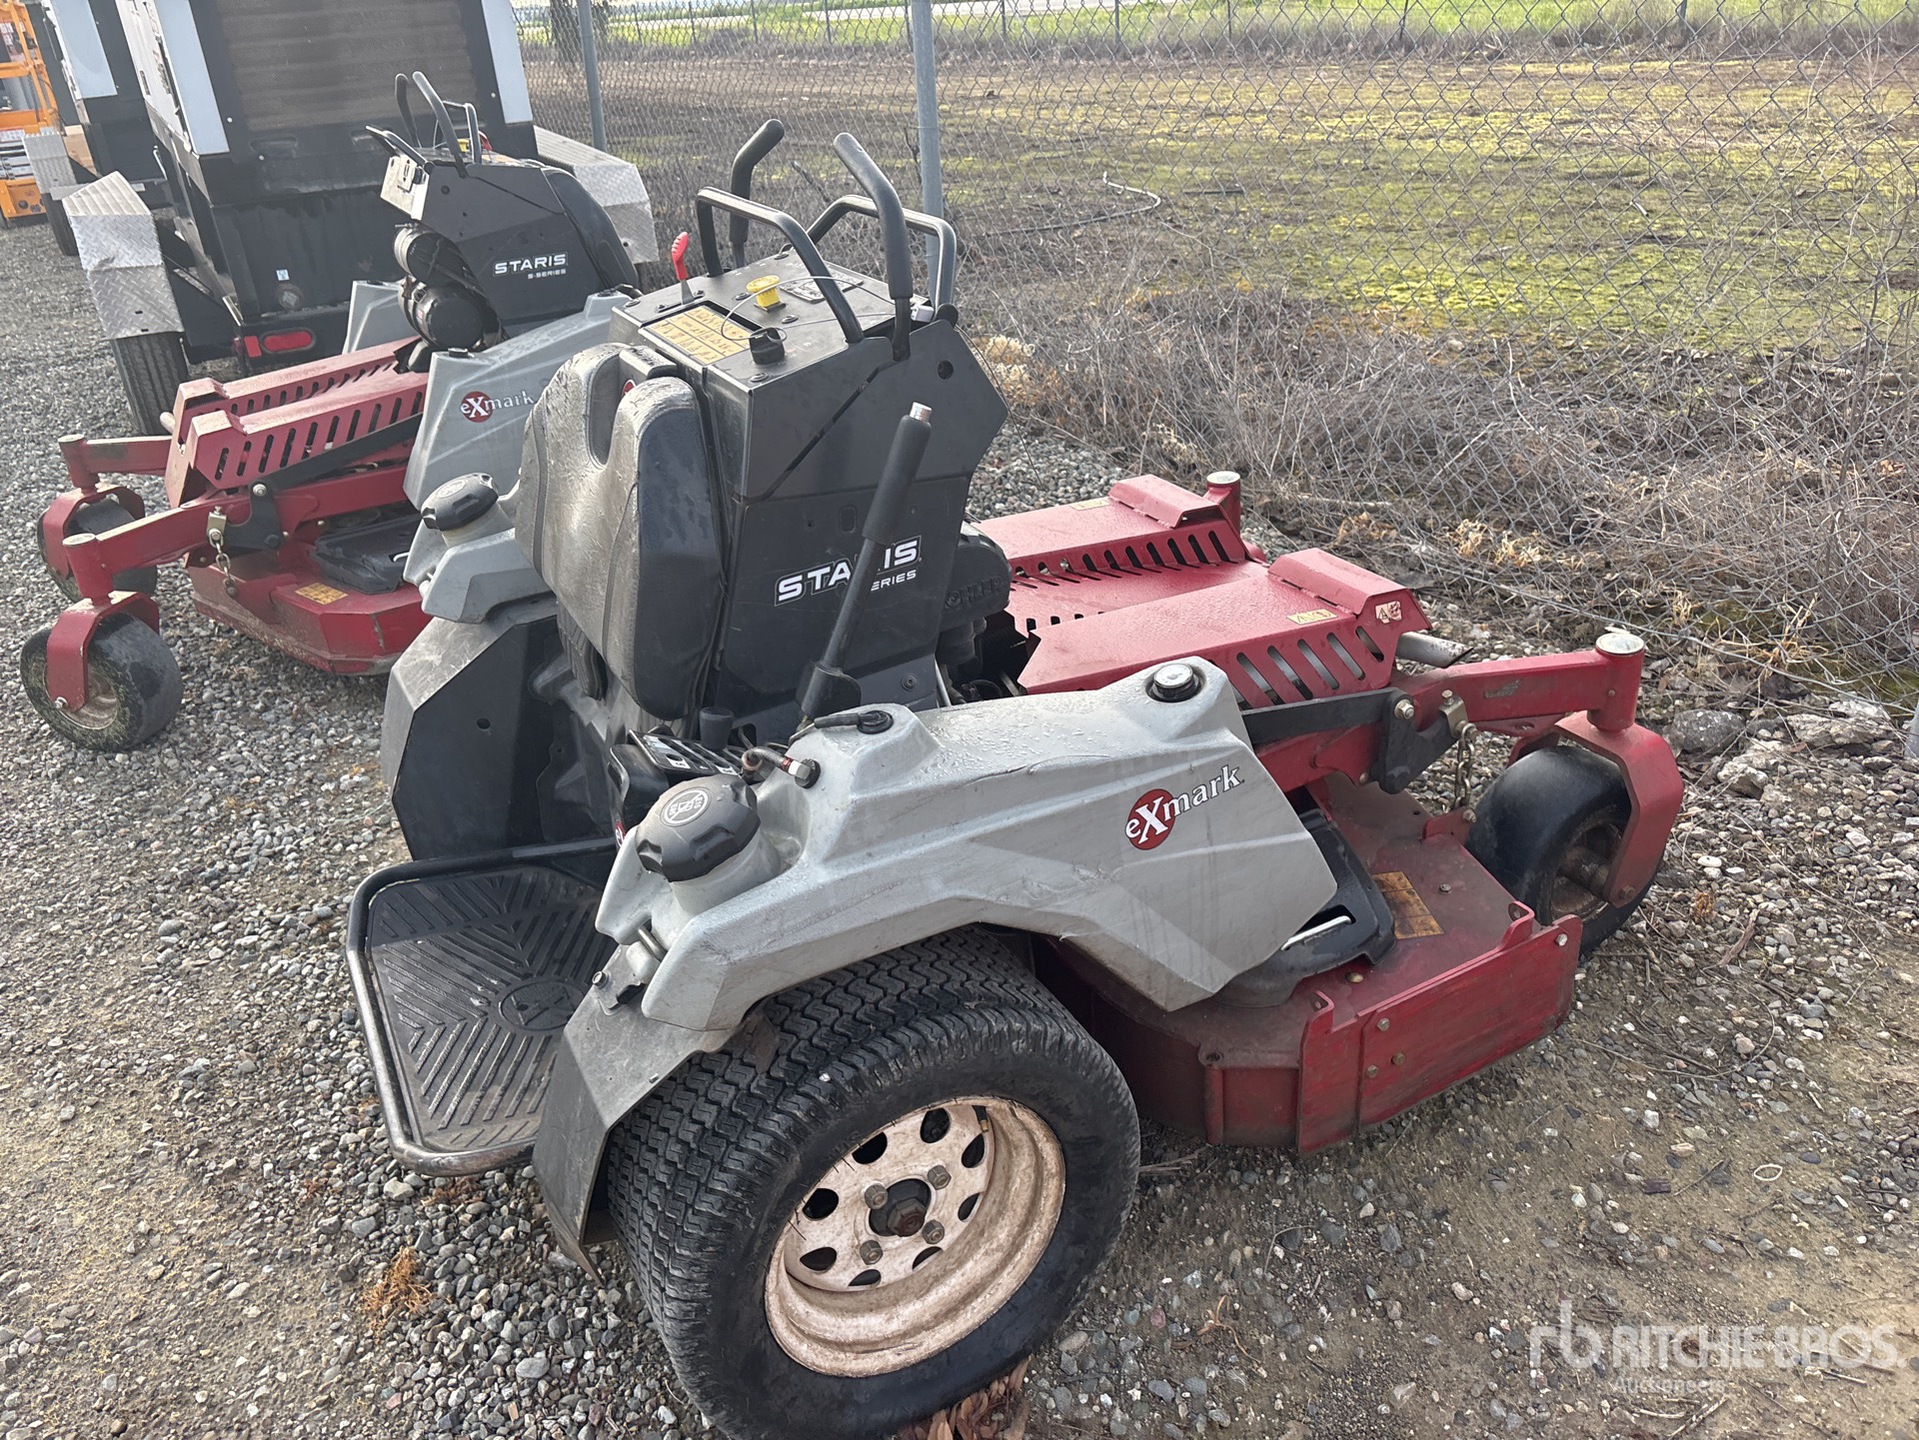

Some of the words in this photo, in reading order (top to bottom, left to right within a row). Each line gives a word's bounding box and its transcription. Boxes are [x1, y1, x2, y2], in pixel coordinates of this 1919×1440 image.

[494, 253, 566, 275] STARIS
[777, 539, 918, 602] STAIS
[870, 569, 917, 592] ERIES
[1124, 764, 1242, 845] eXmark
